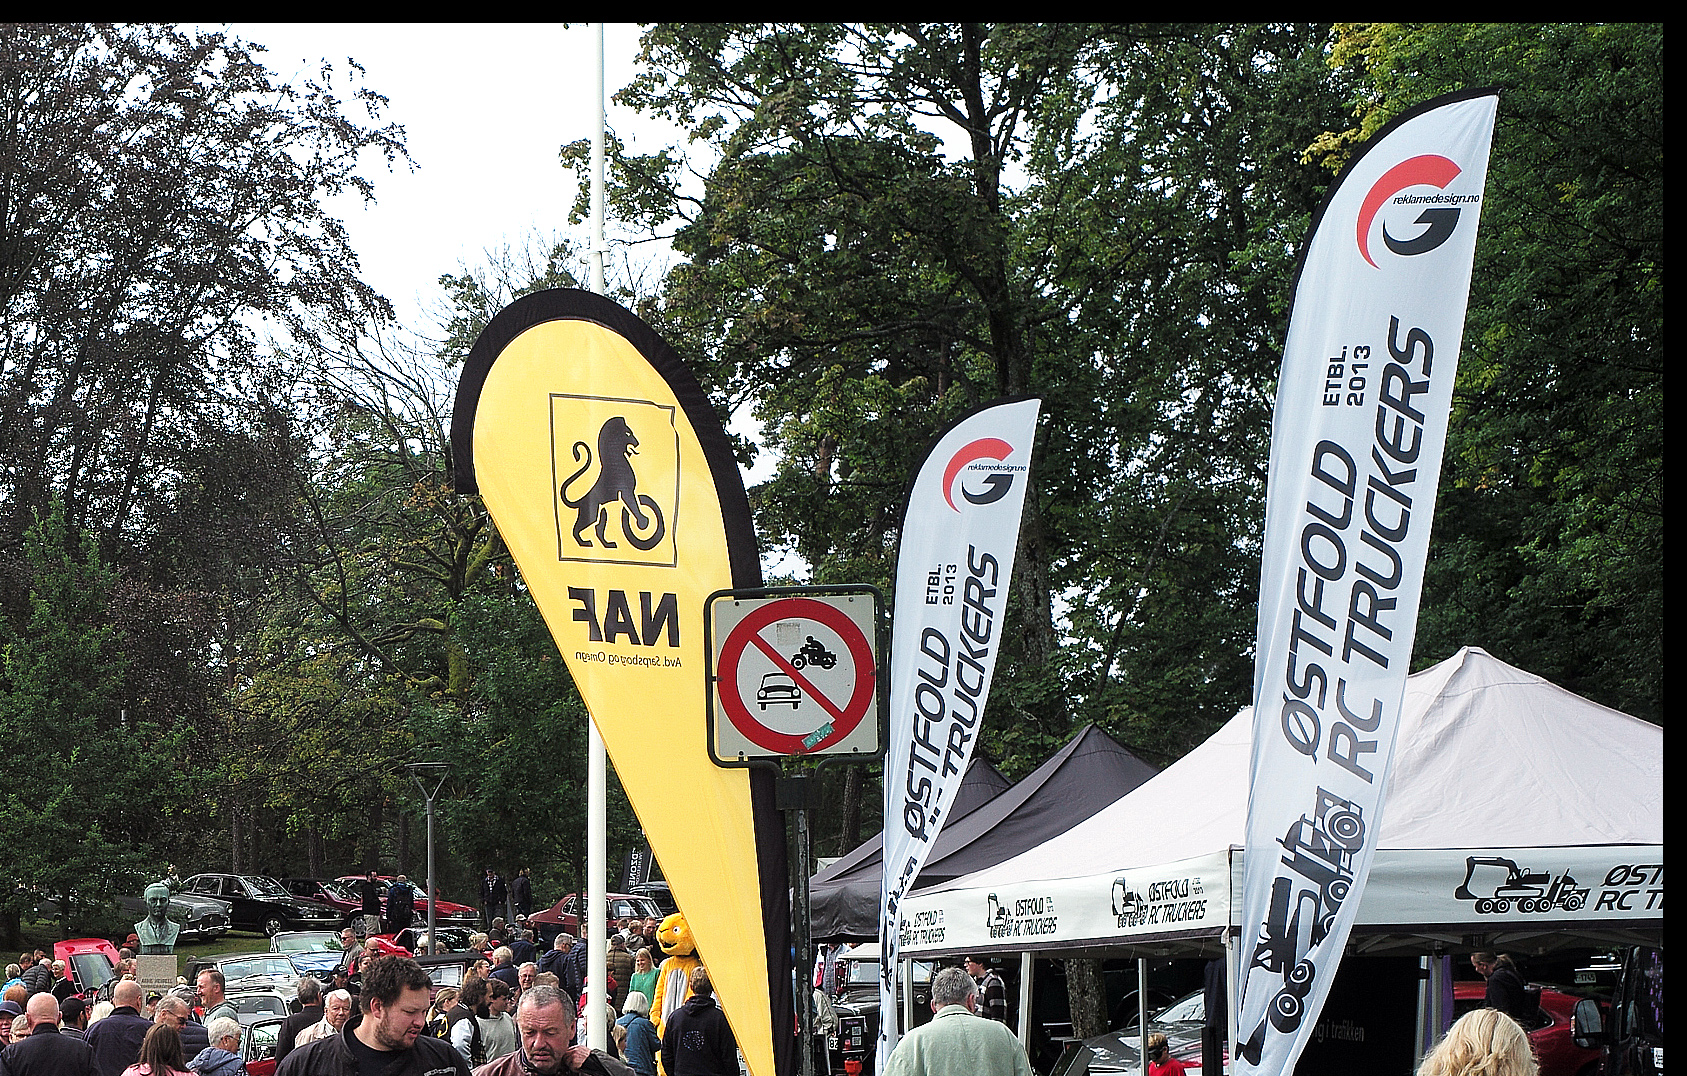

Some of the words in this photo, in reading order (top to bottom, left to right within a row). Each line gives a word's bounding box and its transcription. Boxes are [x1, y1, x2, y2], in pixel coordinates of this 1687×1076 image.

[1392, 191, 1480, 206] reklamedesign.no
[1323, 345, 1349, 408] ETBL.
[1347, 344, 1372, 408] 2013
[1342, 314, 1435, 670] TRUCKERS
[942, 563, 958, 607] 2013
[1281, 438, 1358, 763] ØSTFOLD
[942, 543, 999, 778] TRUCKERS
[904, 626, 951, 841] ØSTFOLD
[1326, 677, 1384, 784] RC
[1594, 889, 1641, 912] RC
[1600, 864, 1663, 888] ØST
